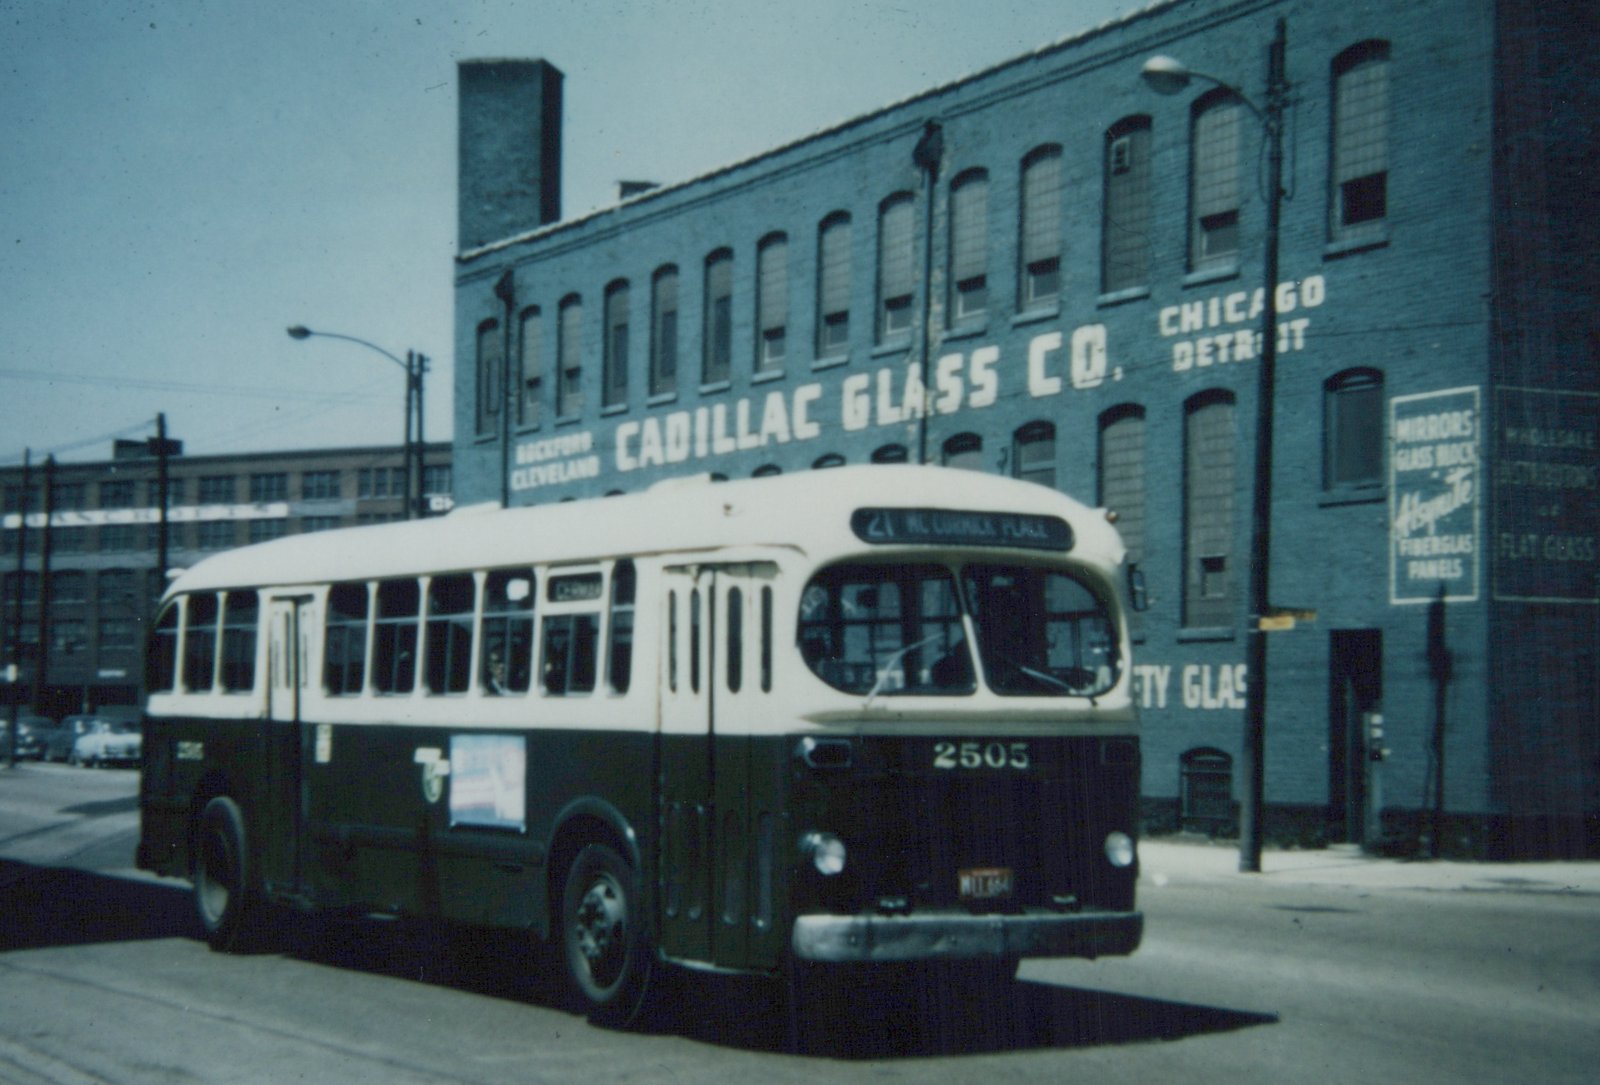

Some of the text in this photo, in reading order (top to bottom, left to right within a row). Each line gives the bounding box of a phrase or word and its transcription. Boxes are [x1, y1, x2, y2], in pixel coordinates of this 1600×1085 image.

[1159, 274, 1325, 337] CHICAGO
[1172, 317, 1310, 372] DETRIT
[616, 382, 822, 473] CADILLAC
[842, 344, 1000, 432] GLASS
[1396, 410, 1474, 444] MIRRORS
[510, 455, 600, 491] CLEVELAND
[1407, 558, 1464, 580] PANELS
[1182, 663, 1248, 709] GLAS
[933, 743, 1030, 769] 2505
